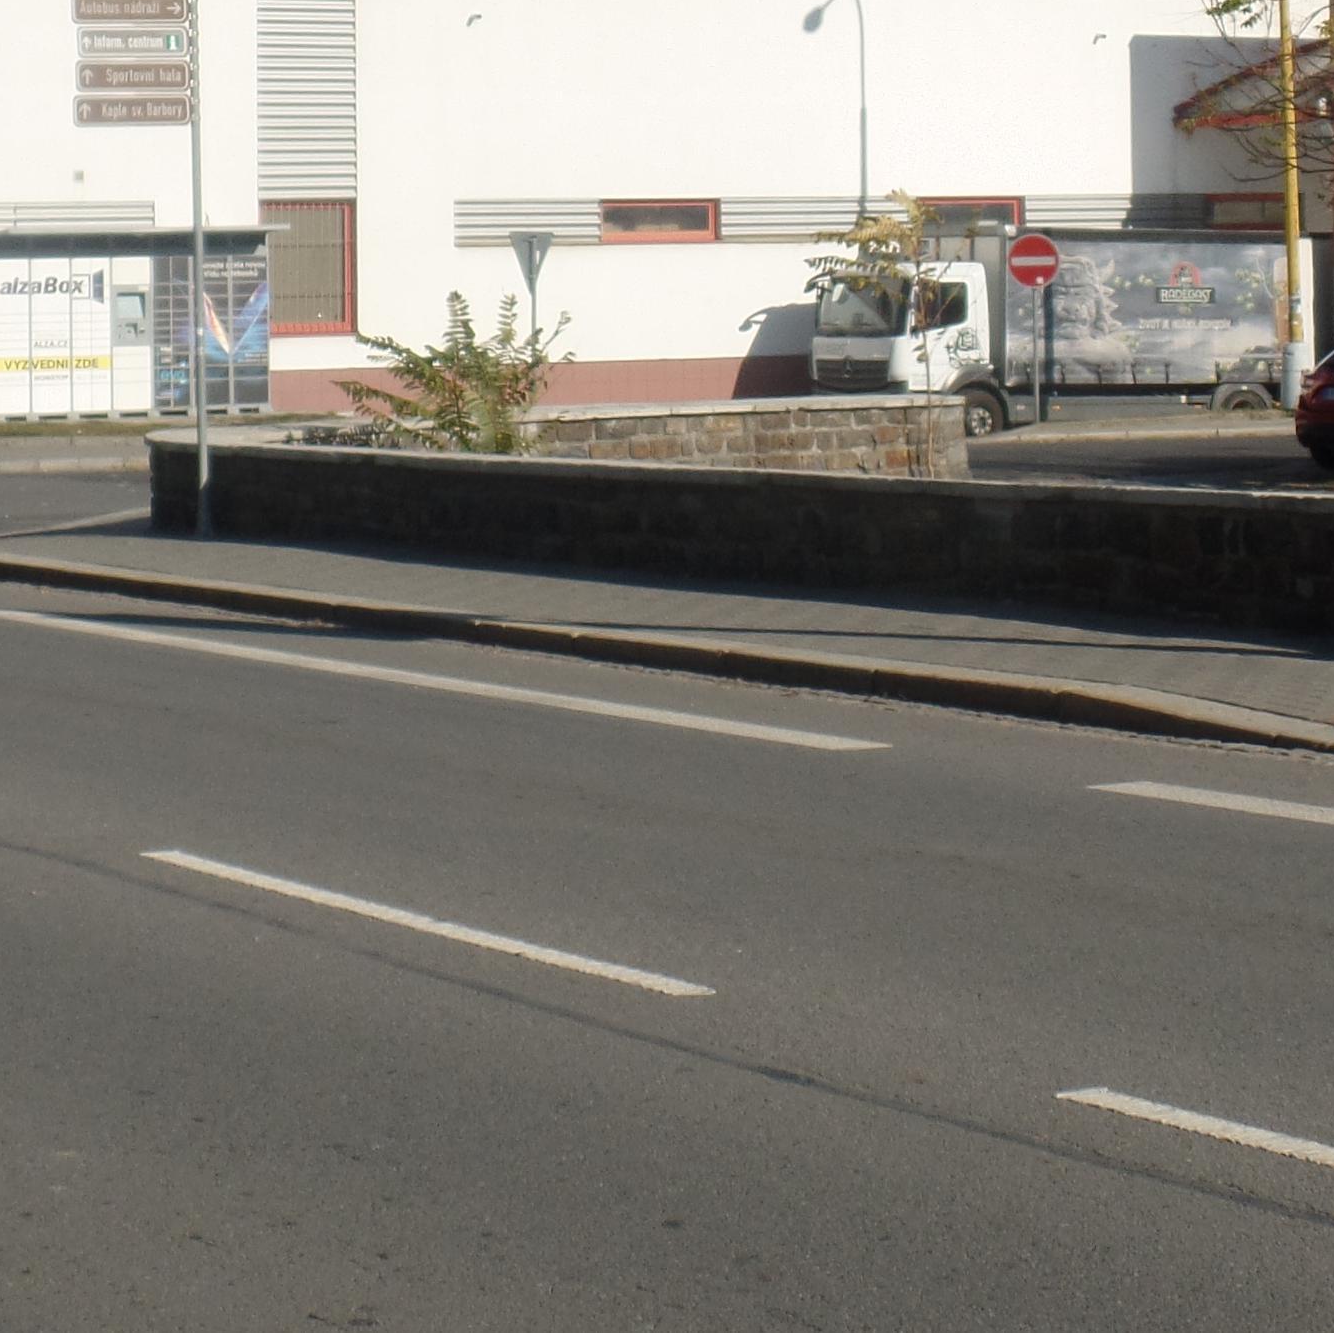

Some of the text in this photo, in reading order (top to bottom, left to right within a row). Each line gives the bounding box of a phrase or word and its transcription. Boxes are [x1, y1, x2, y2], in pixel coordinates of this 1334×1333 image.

[127, 35, 164, 48] centrum
[105, 68, 182, 86] Sportovní hala
[101, 104, 127, 119] Kaple
[146, 102, 183, 118] Barbory
[0, 276, 85, 295] alzaBox
[1160, 288, 1213, 303] RADEGAST
[4, 358, 100, 371] VYZVEDNI ZDE
